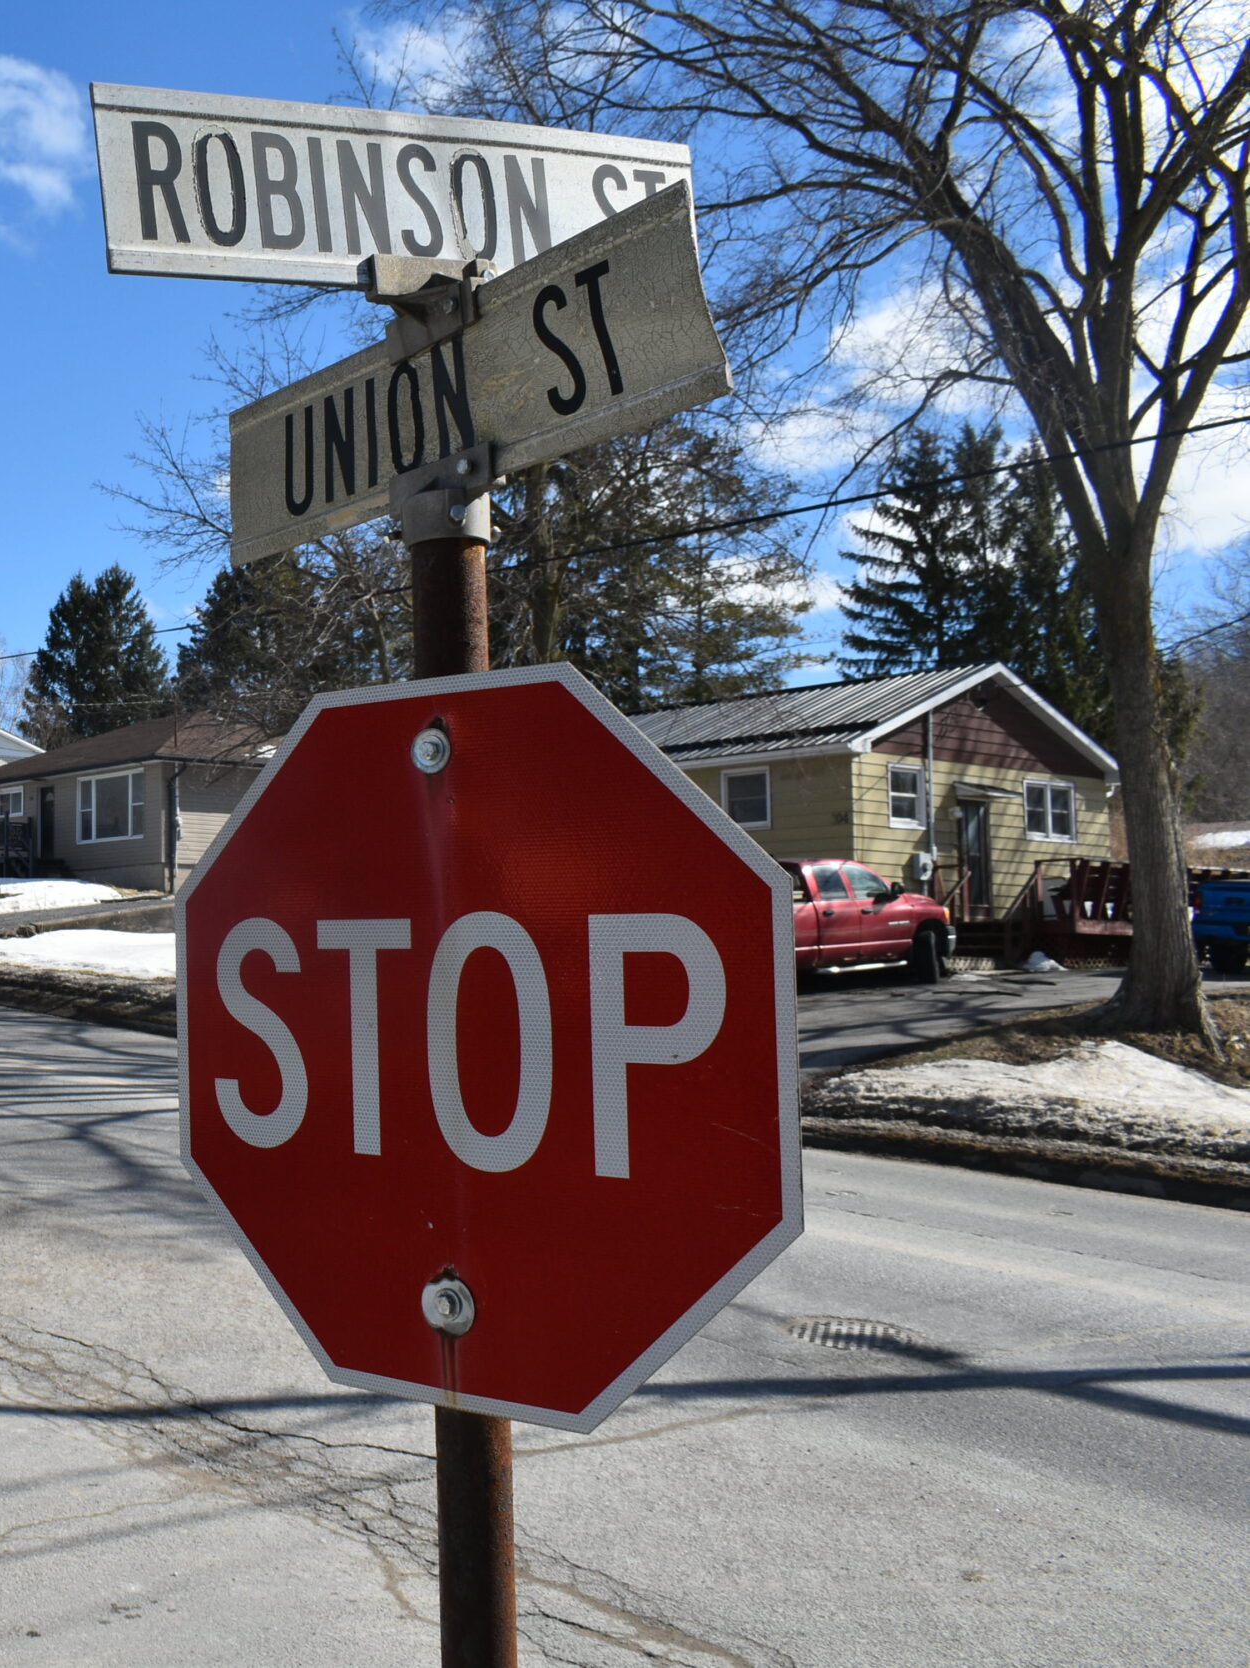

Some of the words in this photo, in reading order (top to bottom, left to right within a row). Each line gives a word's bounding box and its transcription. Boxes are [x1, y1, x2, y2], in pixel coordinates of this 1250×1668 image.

[132, 121, 552, 267] ROBINSON
[284, 341, 475, 516] UNION
[532, 259, 624, 416] ST
[214, 911, 726, 1178] STOP
